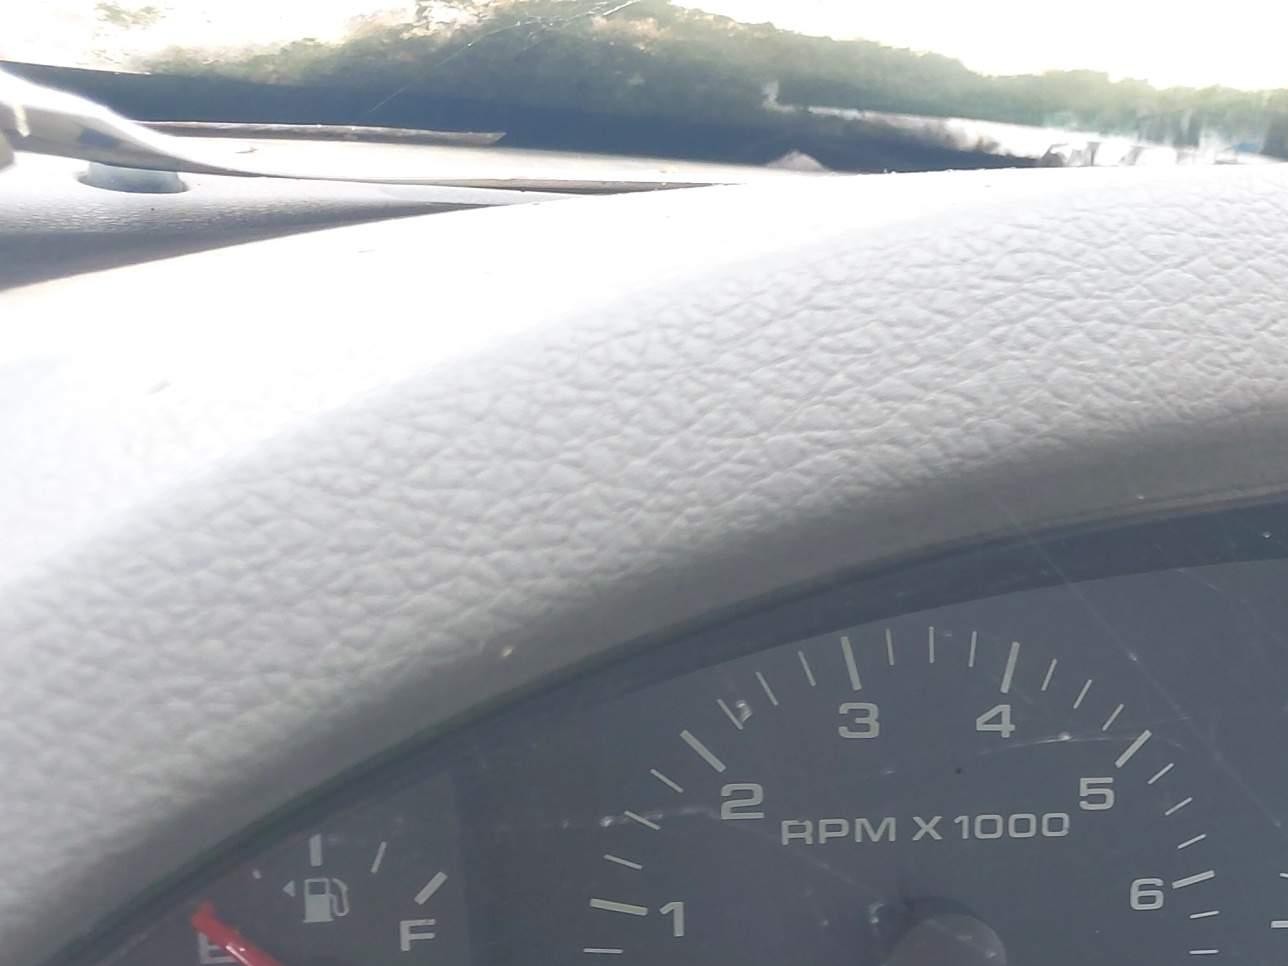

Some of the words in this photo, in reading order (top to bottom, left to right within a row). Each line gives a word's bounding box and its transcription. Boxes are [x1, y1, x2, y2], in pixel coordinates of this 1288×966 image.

[838, 702, 879, 738] 3
[975, 704, 1015, 737] 4
[720, 783, 764, 820] 2
[1078, 777, 1114, 811] 5
[780, 817, 896, 844] RPM
[911, 816, 942, 840] X
[954, 812, 1070, 838] 1000
[1130, 878, 1164, 910] 6
[400, 918, 436, 951] F
[659, 901, 684, 936] 1
